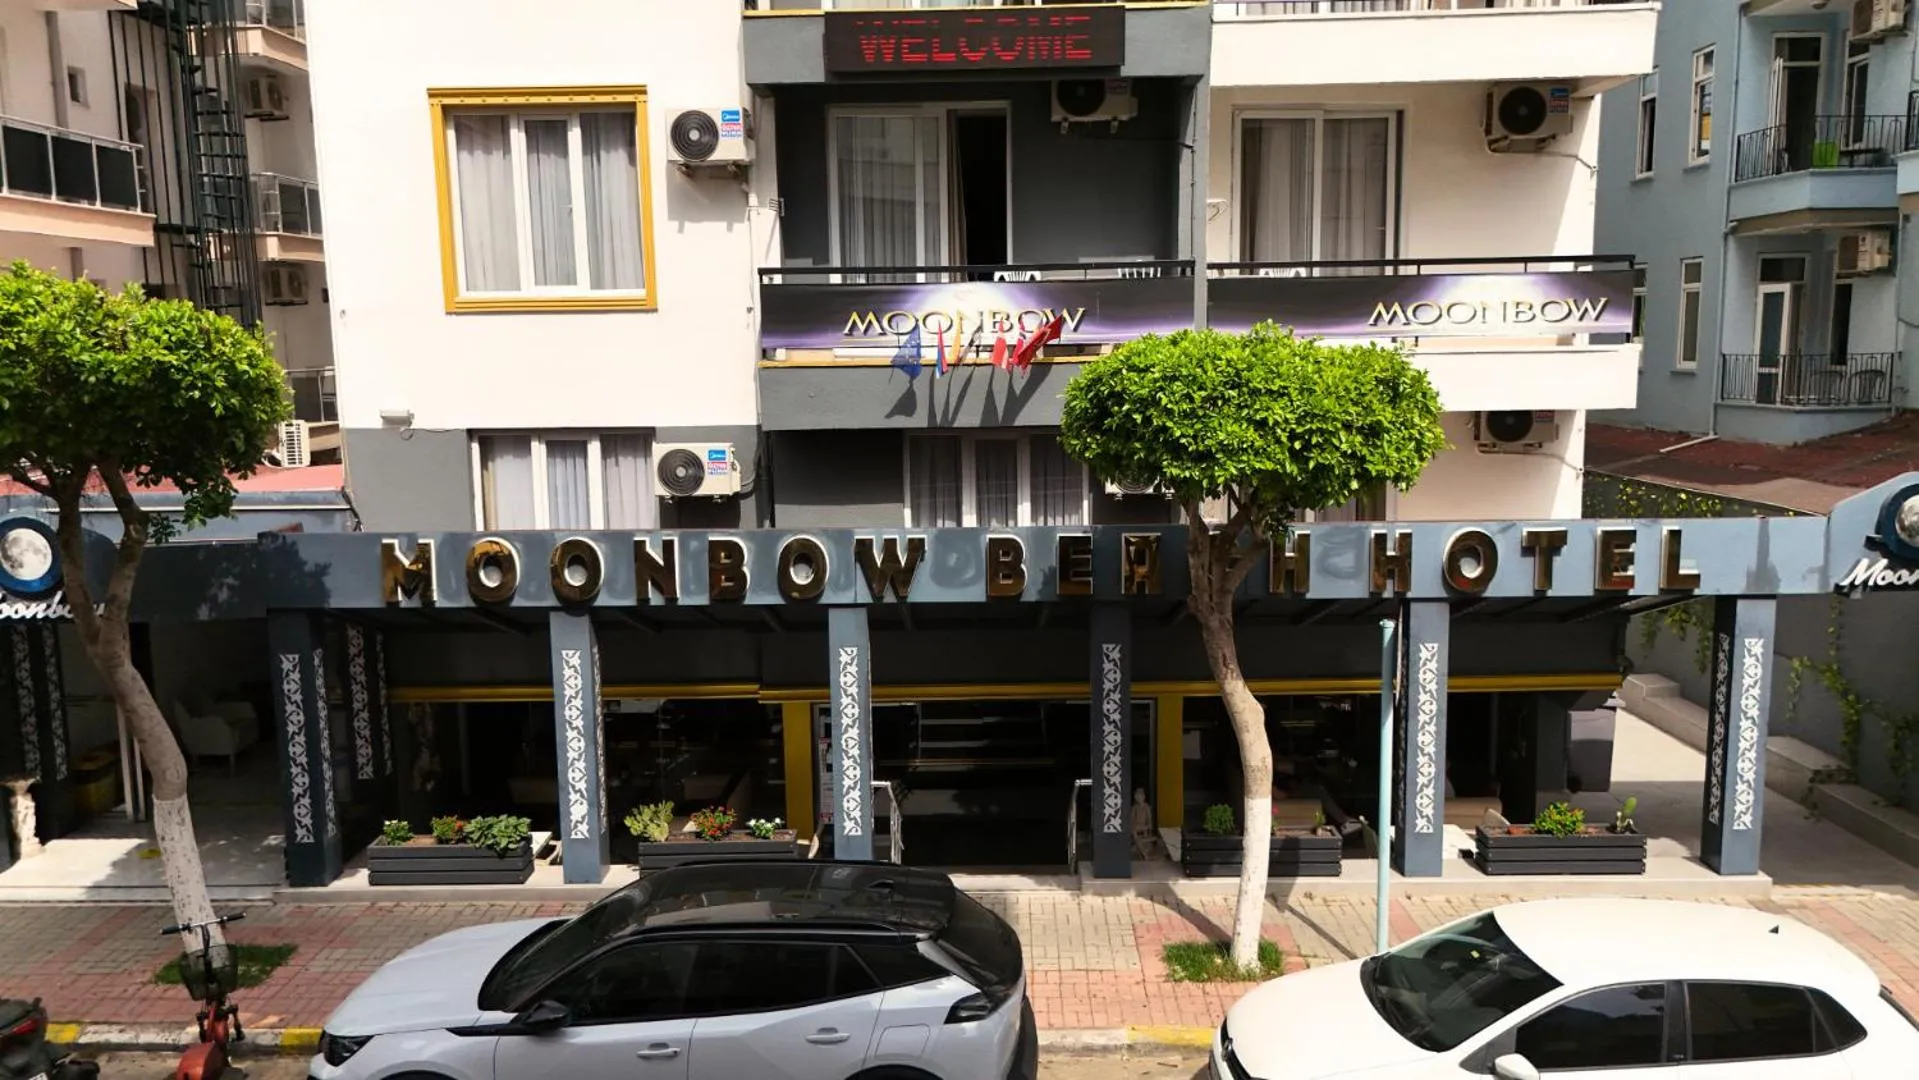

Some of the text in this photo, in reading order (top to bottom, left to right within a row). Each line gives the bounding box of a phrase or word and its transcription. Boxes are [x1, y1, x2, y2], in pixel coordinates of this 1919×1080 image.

[856, 16, 1092, 62] WELCOME
[843, 306, 1086, 336] MOONBOW
[1368, 297, 1609, 327] MOONBOW
[381, 526, 1701, 602] MOONBOW BEAH HOTEL
